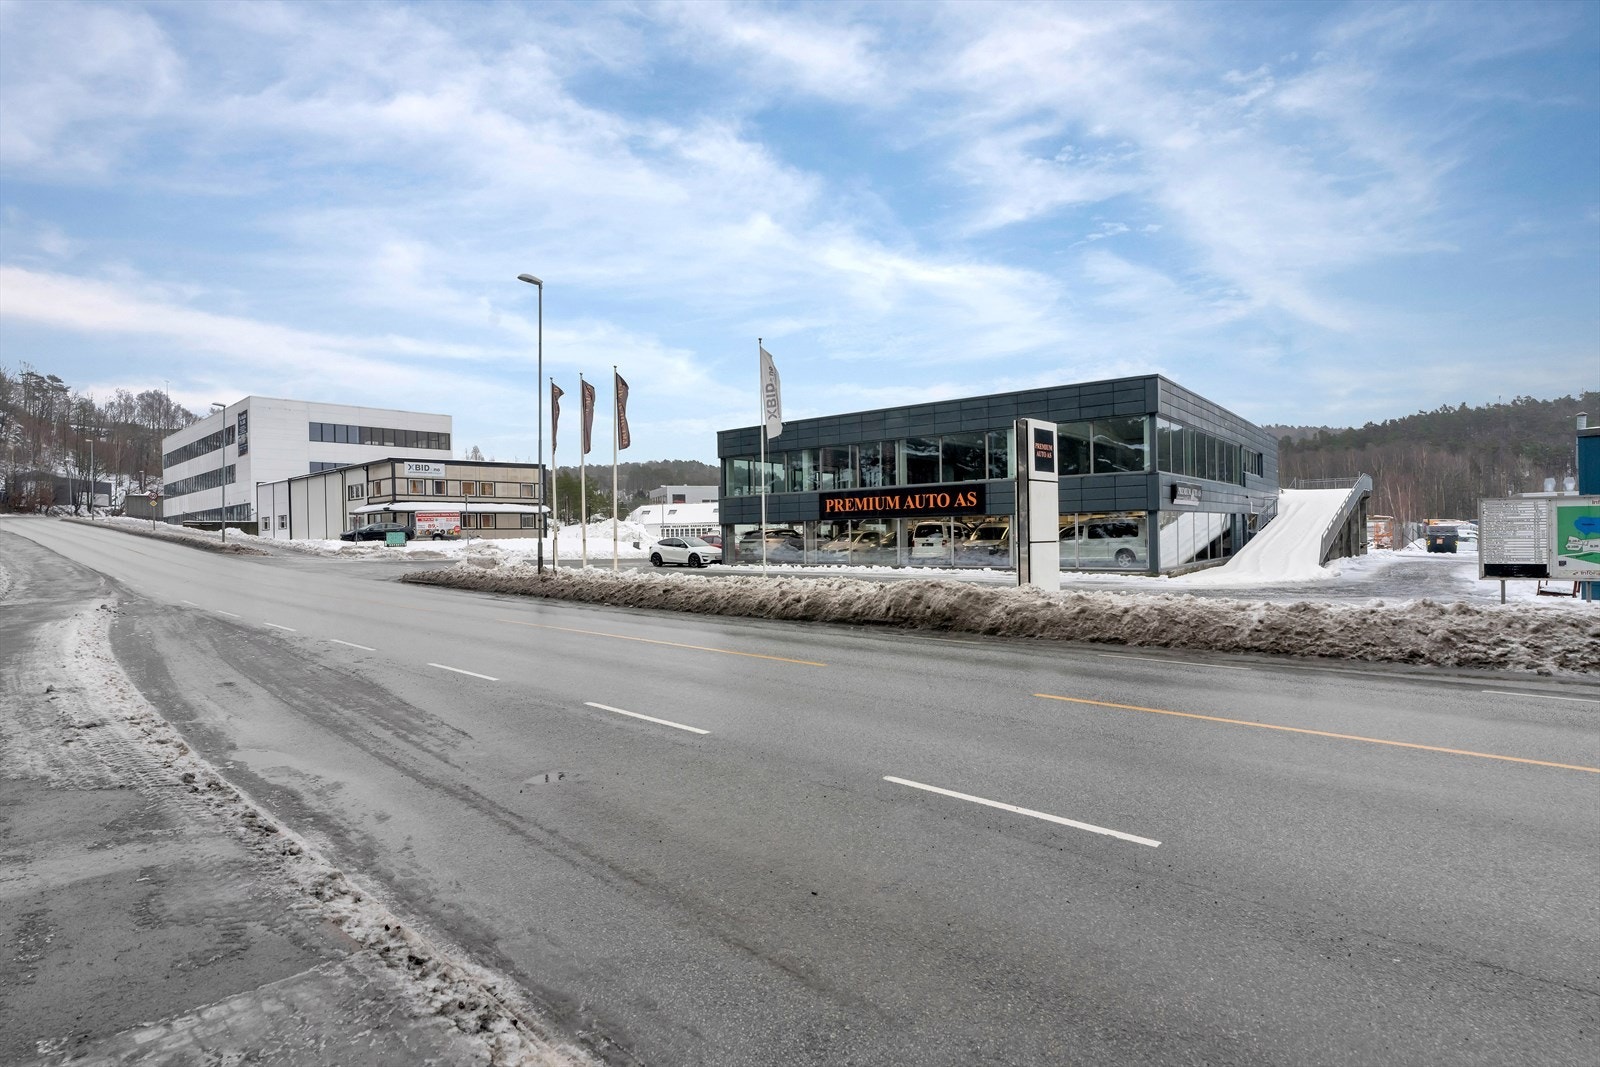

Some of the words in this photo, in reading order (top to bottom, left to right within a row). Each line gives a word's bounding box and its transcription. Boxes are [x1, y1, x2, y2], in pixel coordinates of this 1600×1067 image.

[1034, 443, 1054, 451] PREMIUM
[825, 496, 900, 513] PREMIUM
[903, 493, 950, 509] AUTO
[954, 491, 977, 507] AS
